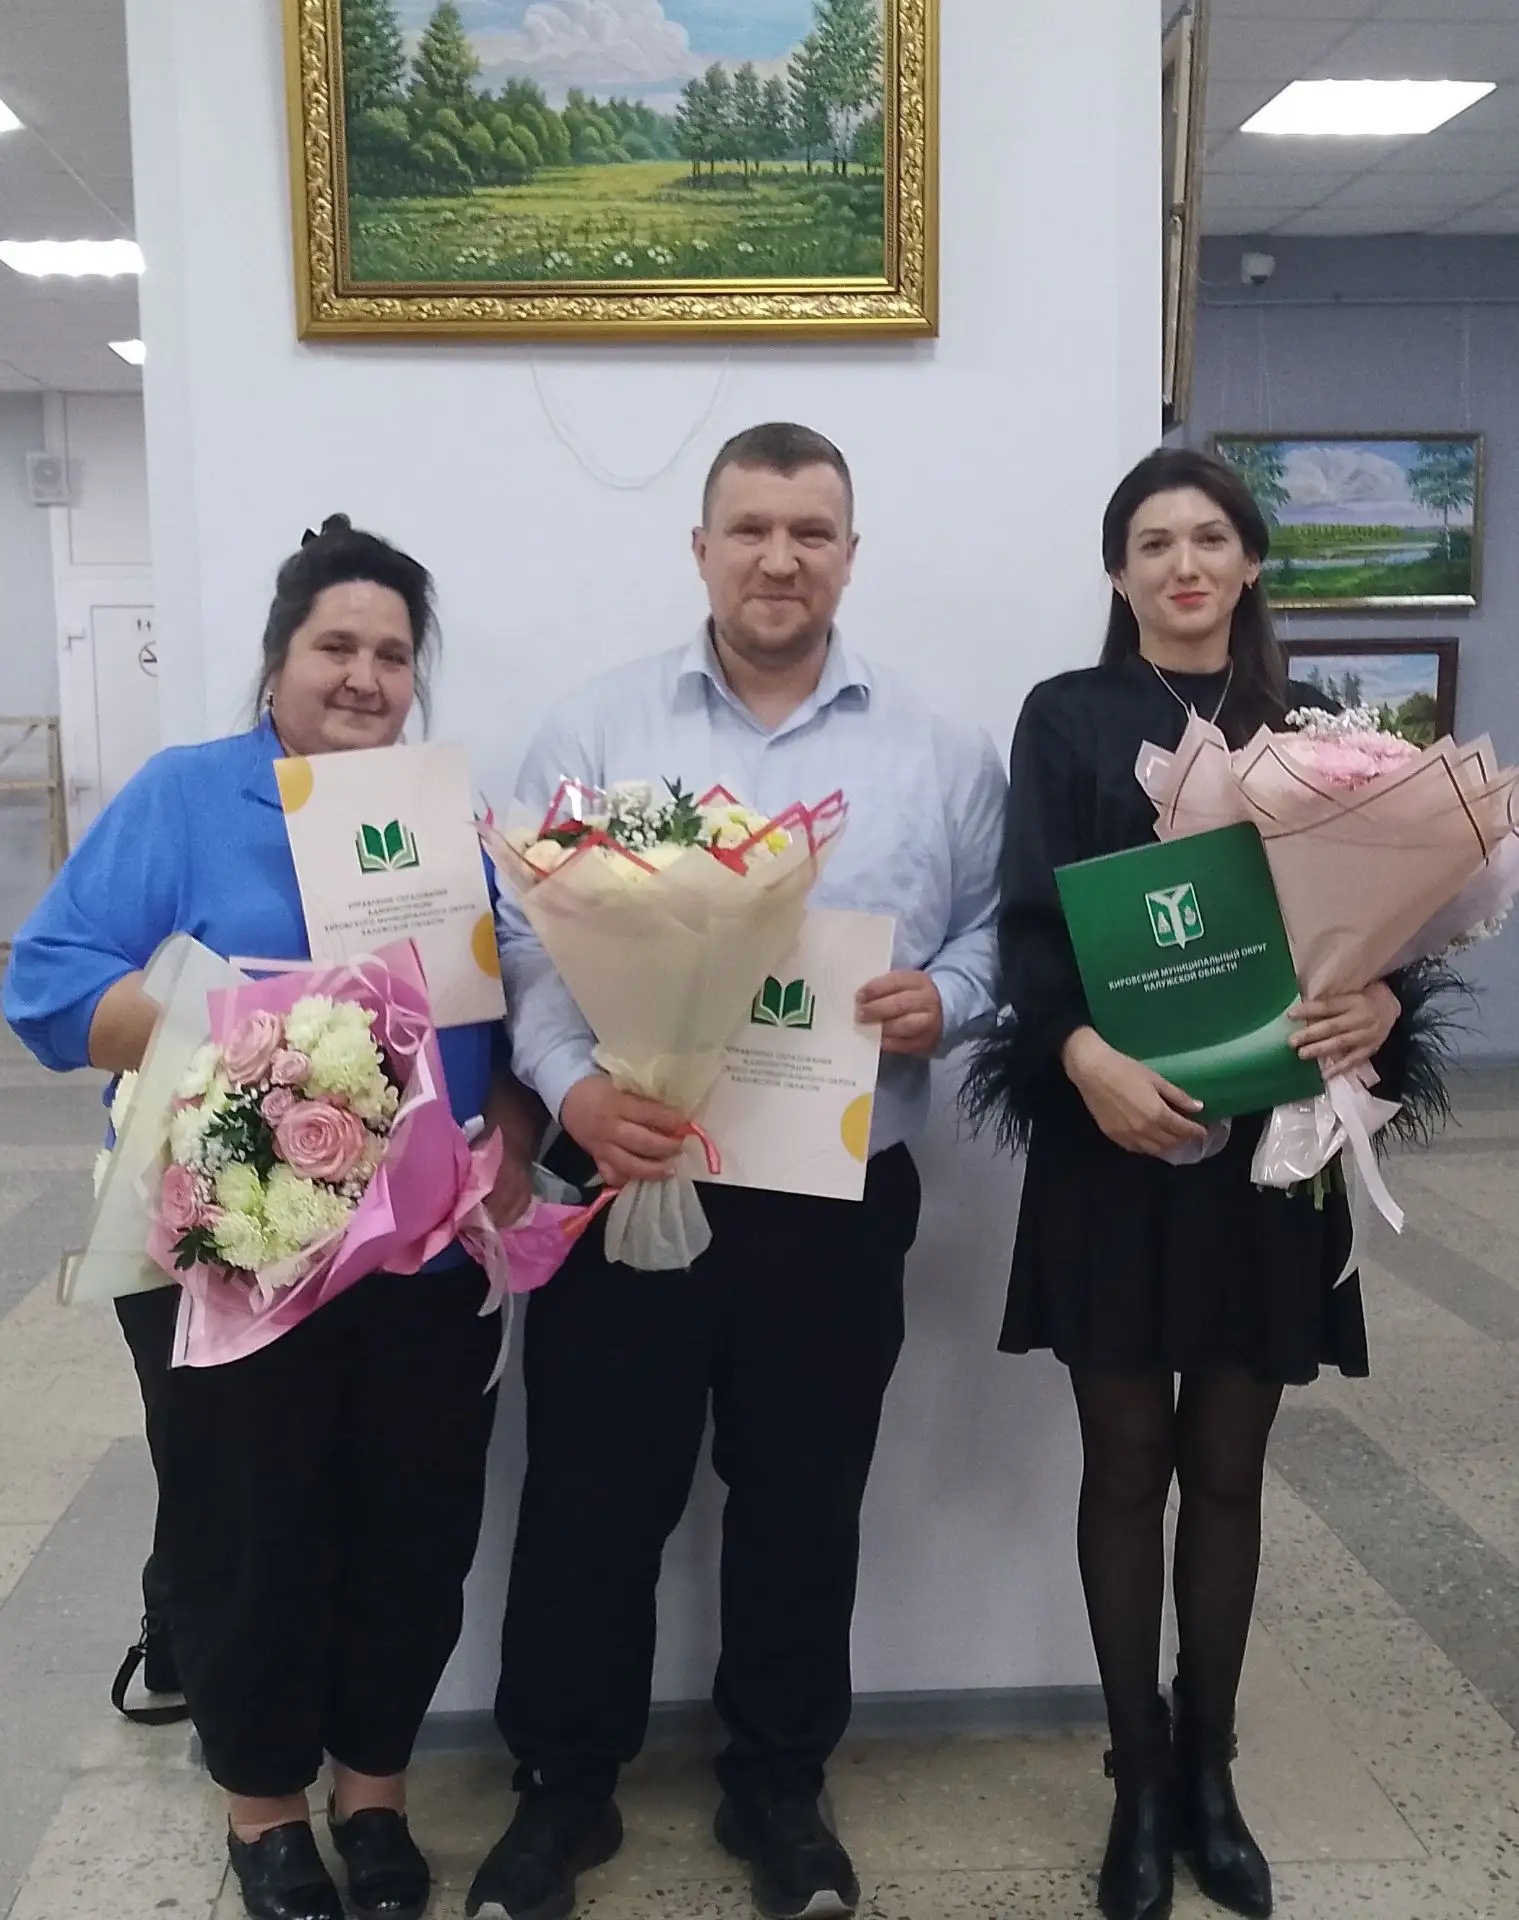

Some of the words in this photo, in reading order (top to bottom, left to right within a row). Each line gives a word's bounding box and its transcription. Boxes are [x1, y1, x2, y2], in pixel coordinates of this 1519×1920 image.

[1108, 969, 1159, 990] КИРОВСКИЙ
[1160, 949, 1240, 976] МУНИЦИПАЛЬНЫЙ
[1240, 942, 1268, 956] ОКРУГ
[1143, 972, 1197, 992] КАЛУЖСКОЙ
[1197, 961, 1238, 978] ОБЛАСТИ
